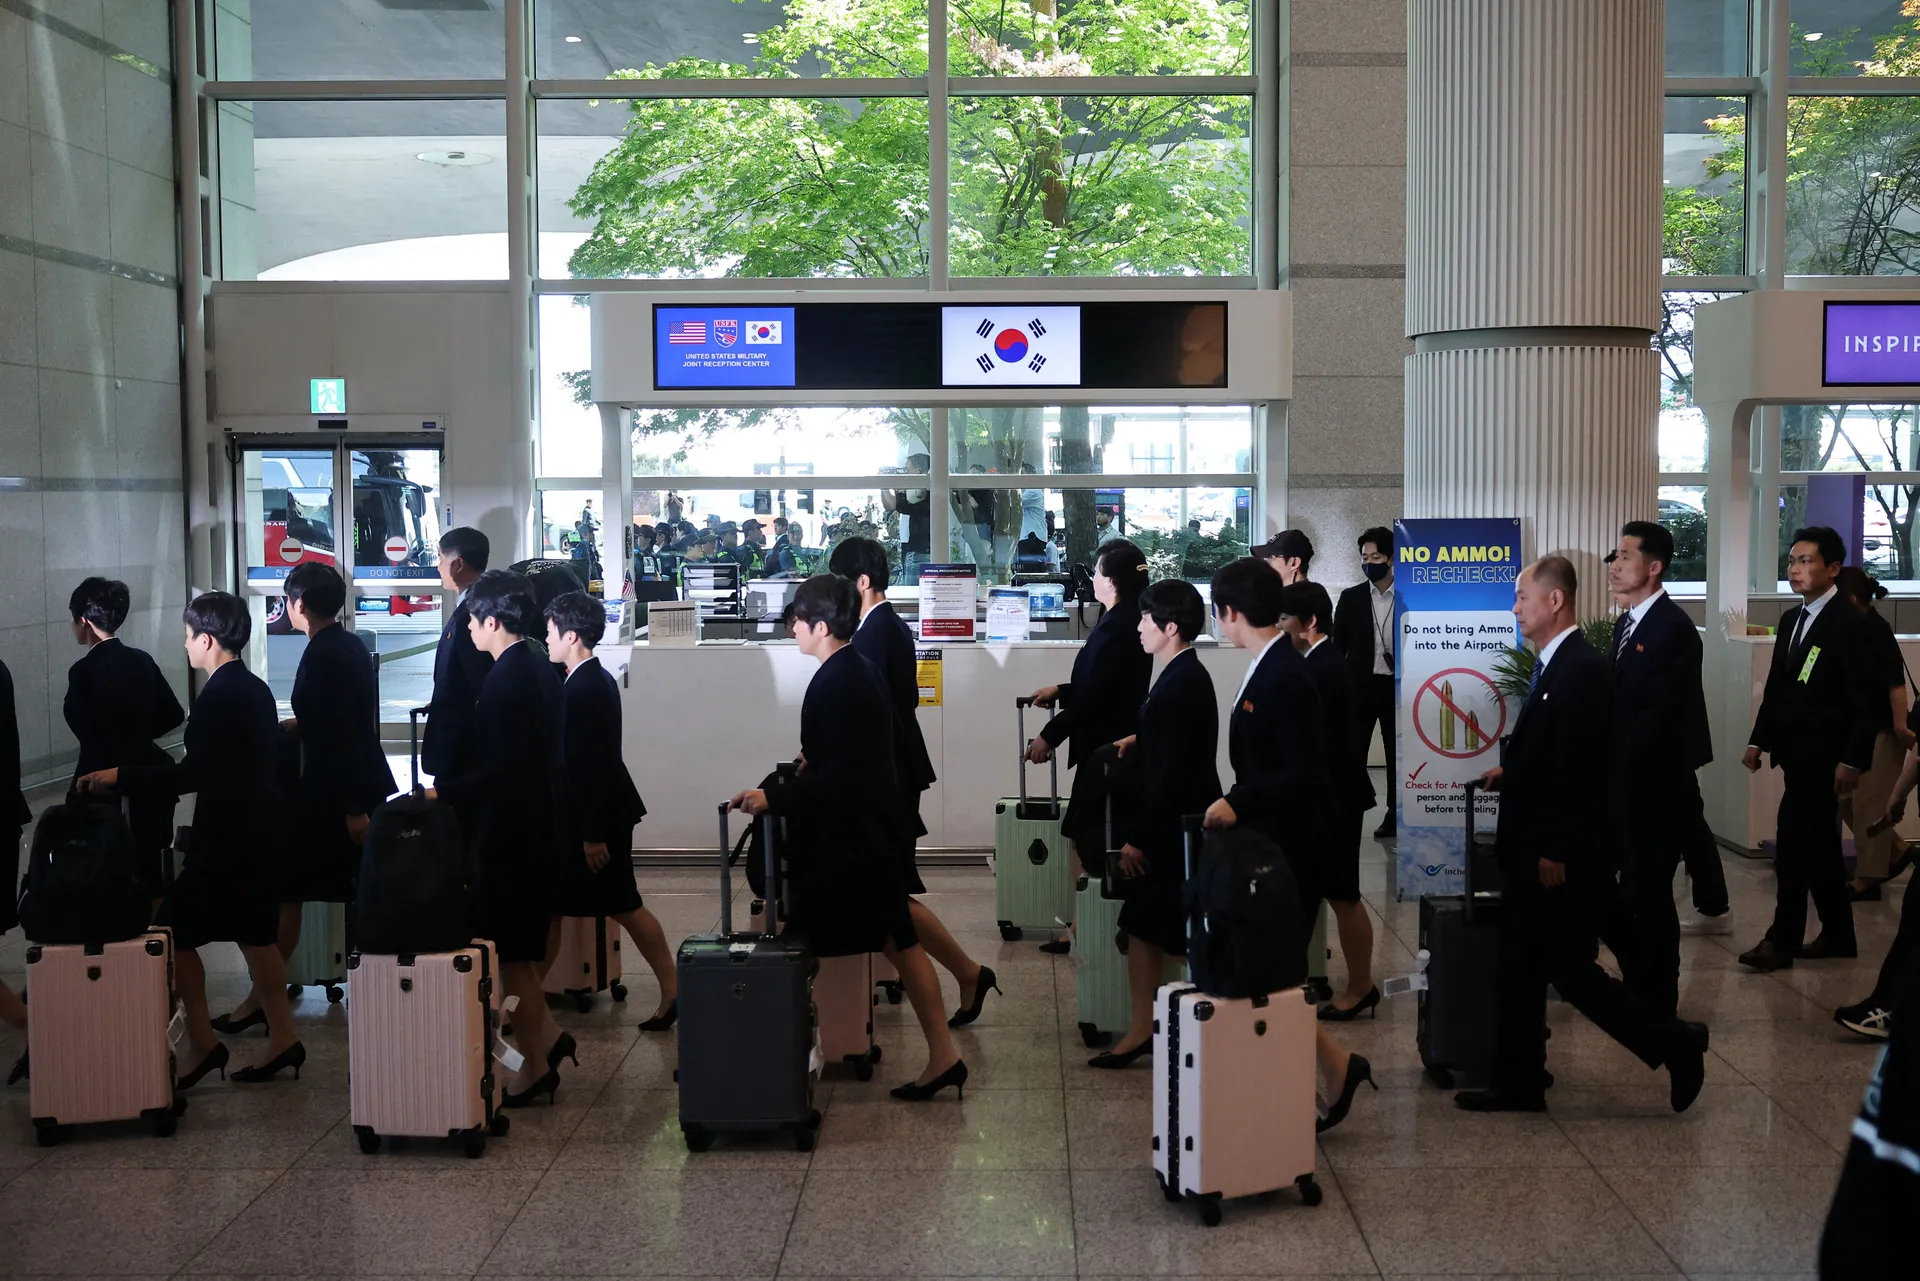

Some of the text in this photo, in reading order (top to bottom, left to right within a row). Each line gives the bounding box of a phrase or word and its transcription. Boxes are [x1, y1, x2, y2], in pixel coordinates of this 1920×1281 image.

[1400, 546, 1511, 563] NO AMMO!
[369, 569, 426, 577] DO NOT EXIT
[1412, 566, 1517, 583] RECHECK!
[1404, 624, 1514, 636] Do not bring Ammo
[1415, 640, 1437, 650] into
[1441, 640, 1460, 650] the
[1405, 781, 1432, 789] Check
[1436, 781, 1447, 789] for
[1416, 793, 1500, 803] person and uggag
[1425, 805, 1497, 815] before traeling
